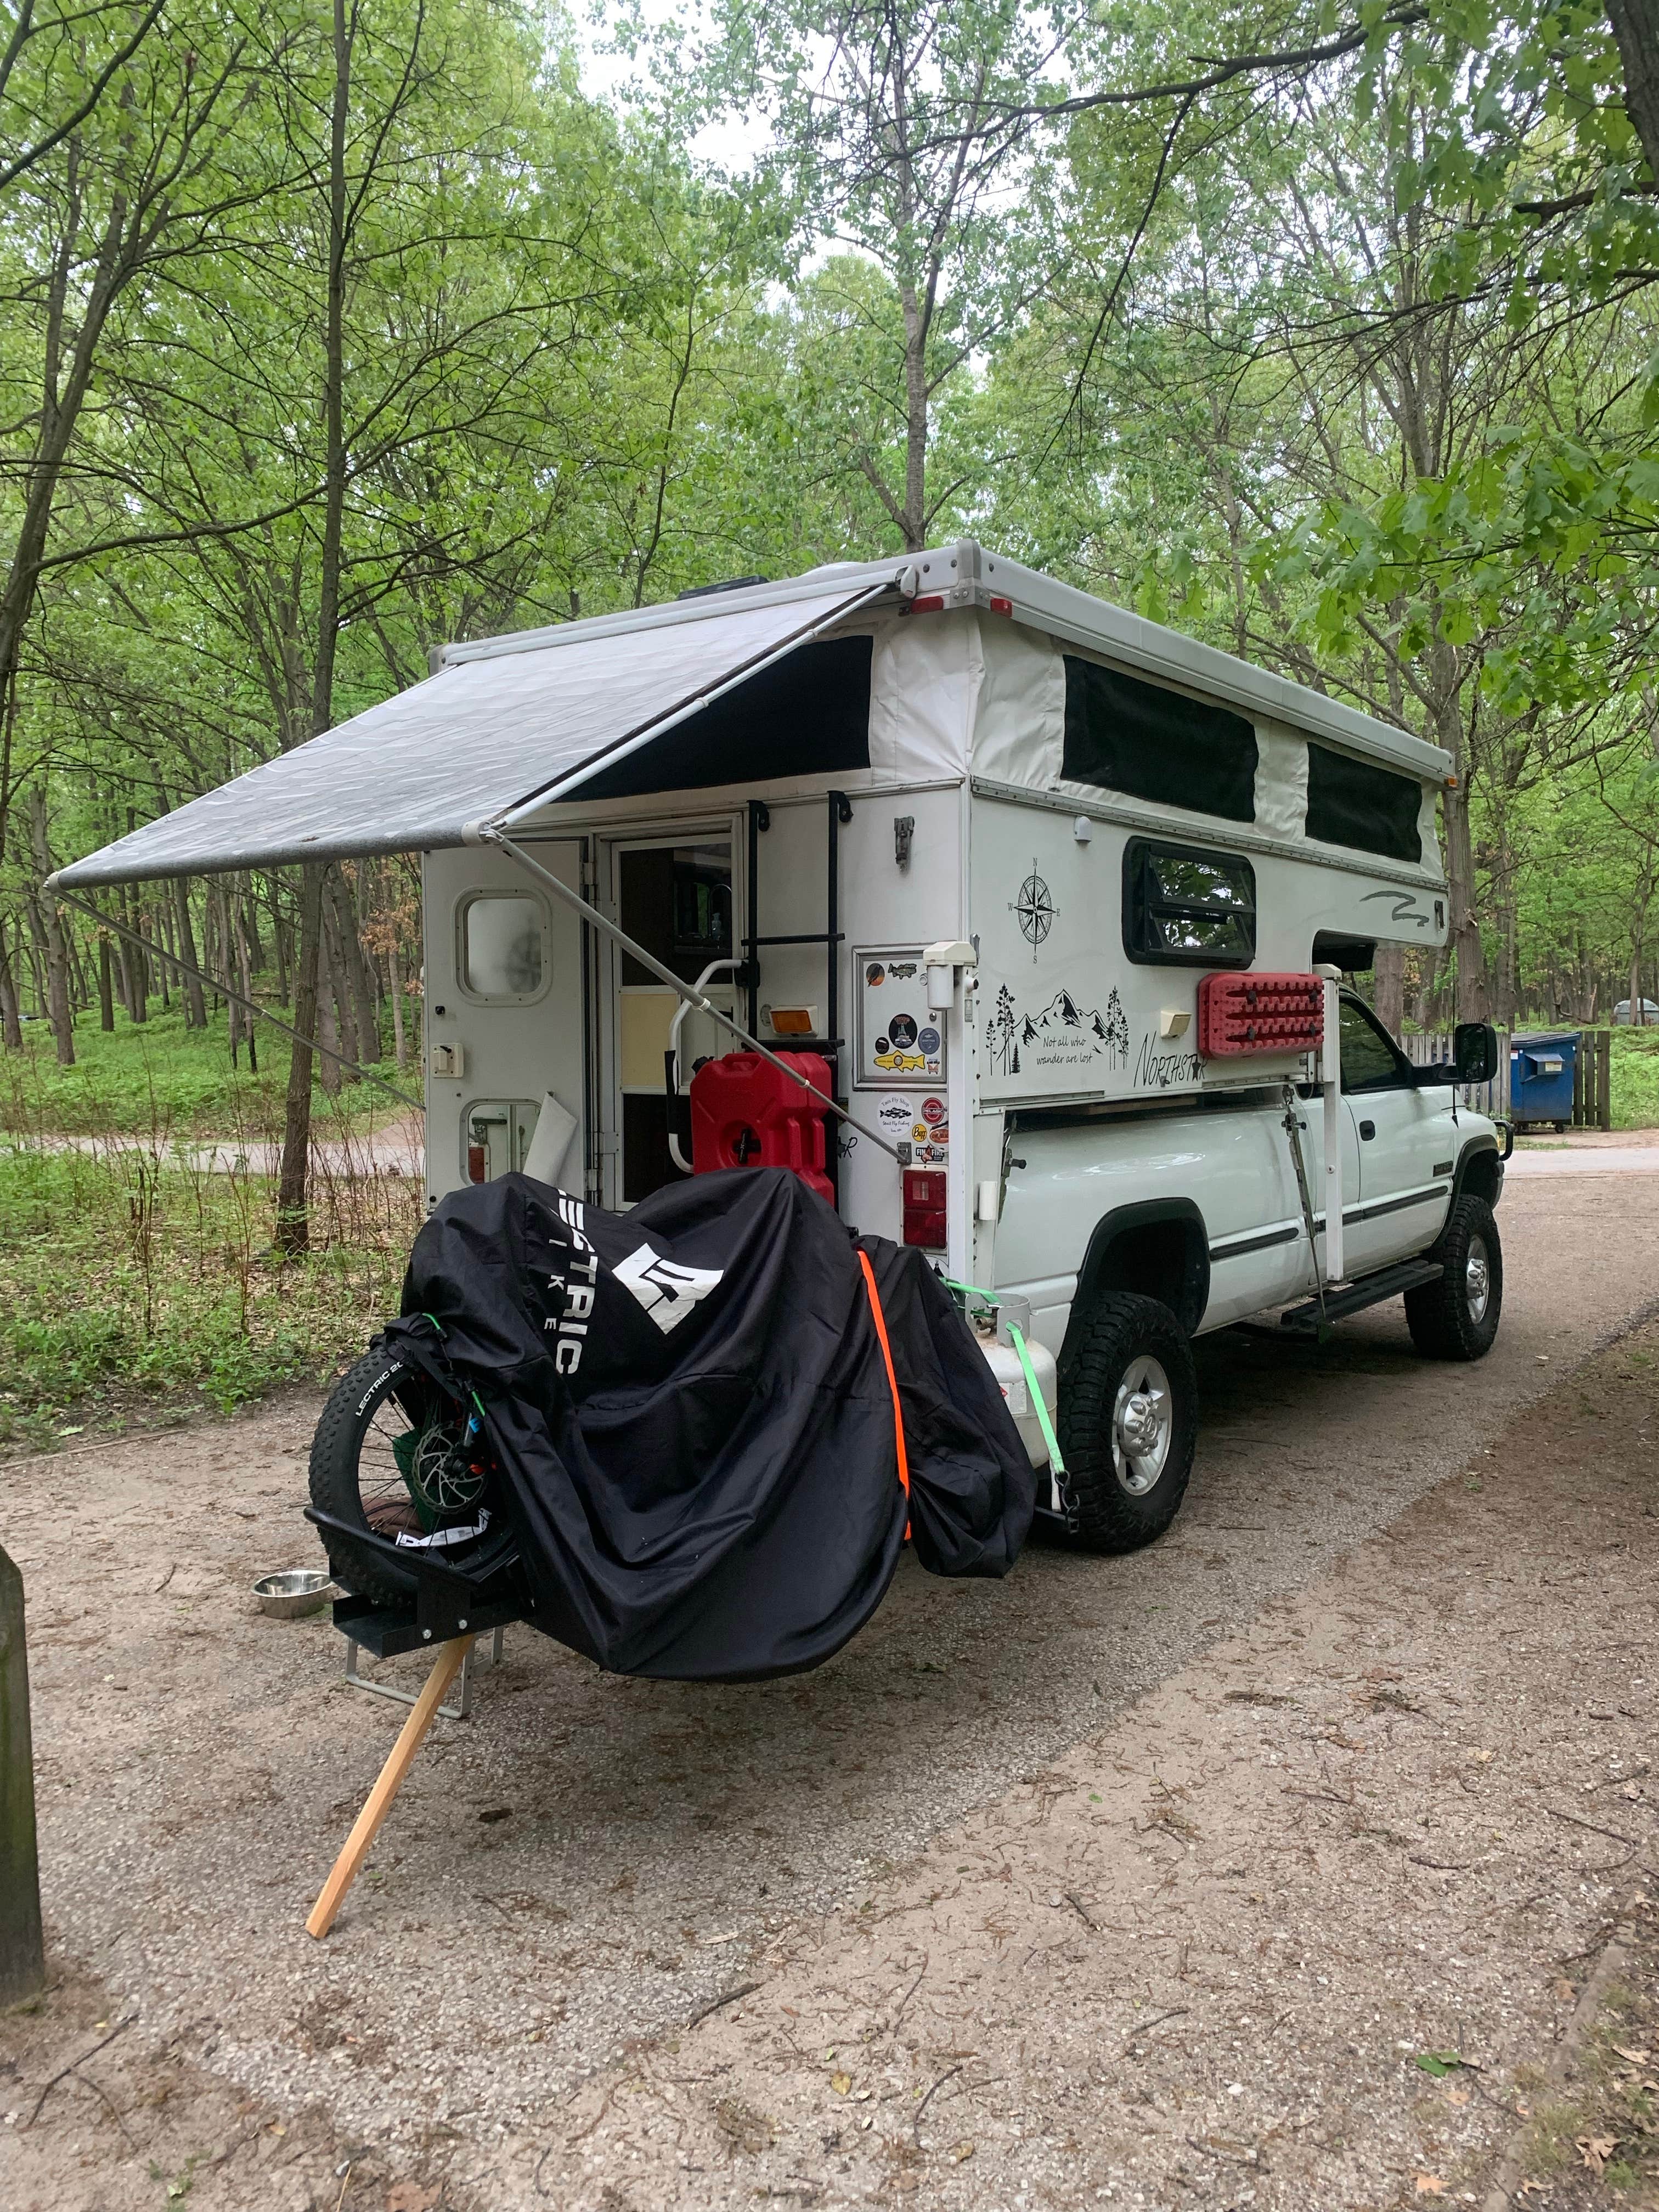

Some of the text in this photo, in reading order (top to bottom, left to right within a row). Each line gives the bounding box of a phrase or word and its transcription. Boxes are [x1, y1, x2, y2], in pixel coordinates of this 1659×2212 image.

[1033, 857, 1038, 866] N
[1007, 902, 1014, 911] W
[1056, 909, 1061, 917] E
[1033, 955, 1037, 964] S
[1043, 1035, 1087, 1048] Not all who
[1036, 1052, 1093, 1065] wander are lost
[899, 1098, 910, 1107] Shop
[556, 1189, 598, 1374] ECTRIC
[355, 1370, 391, 1417] LECTRIC
